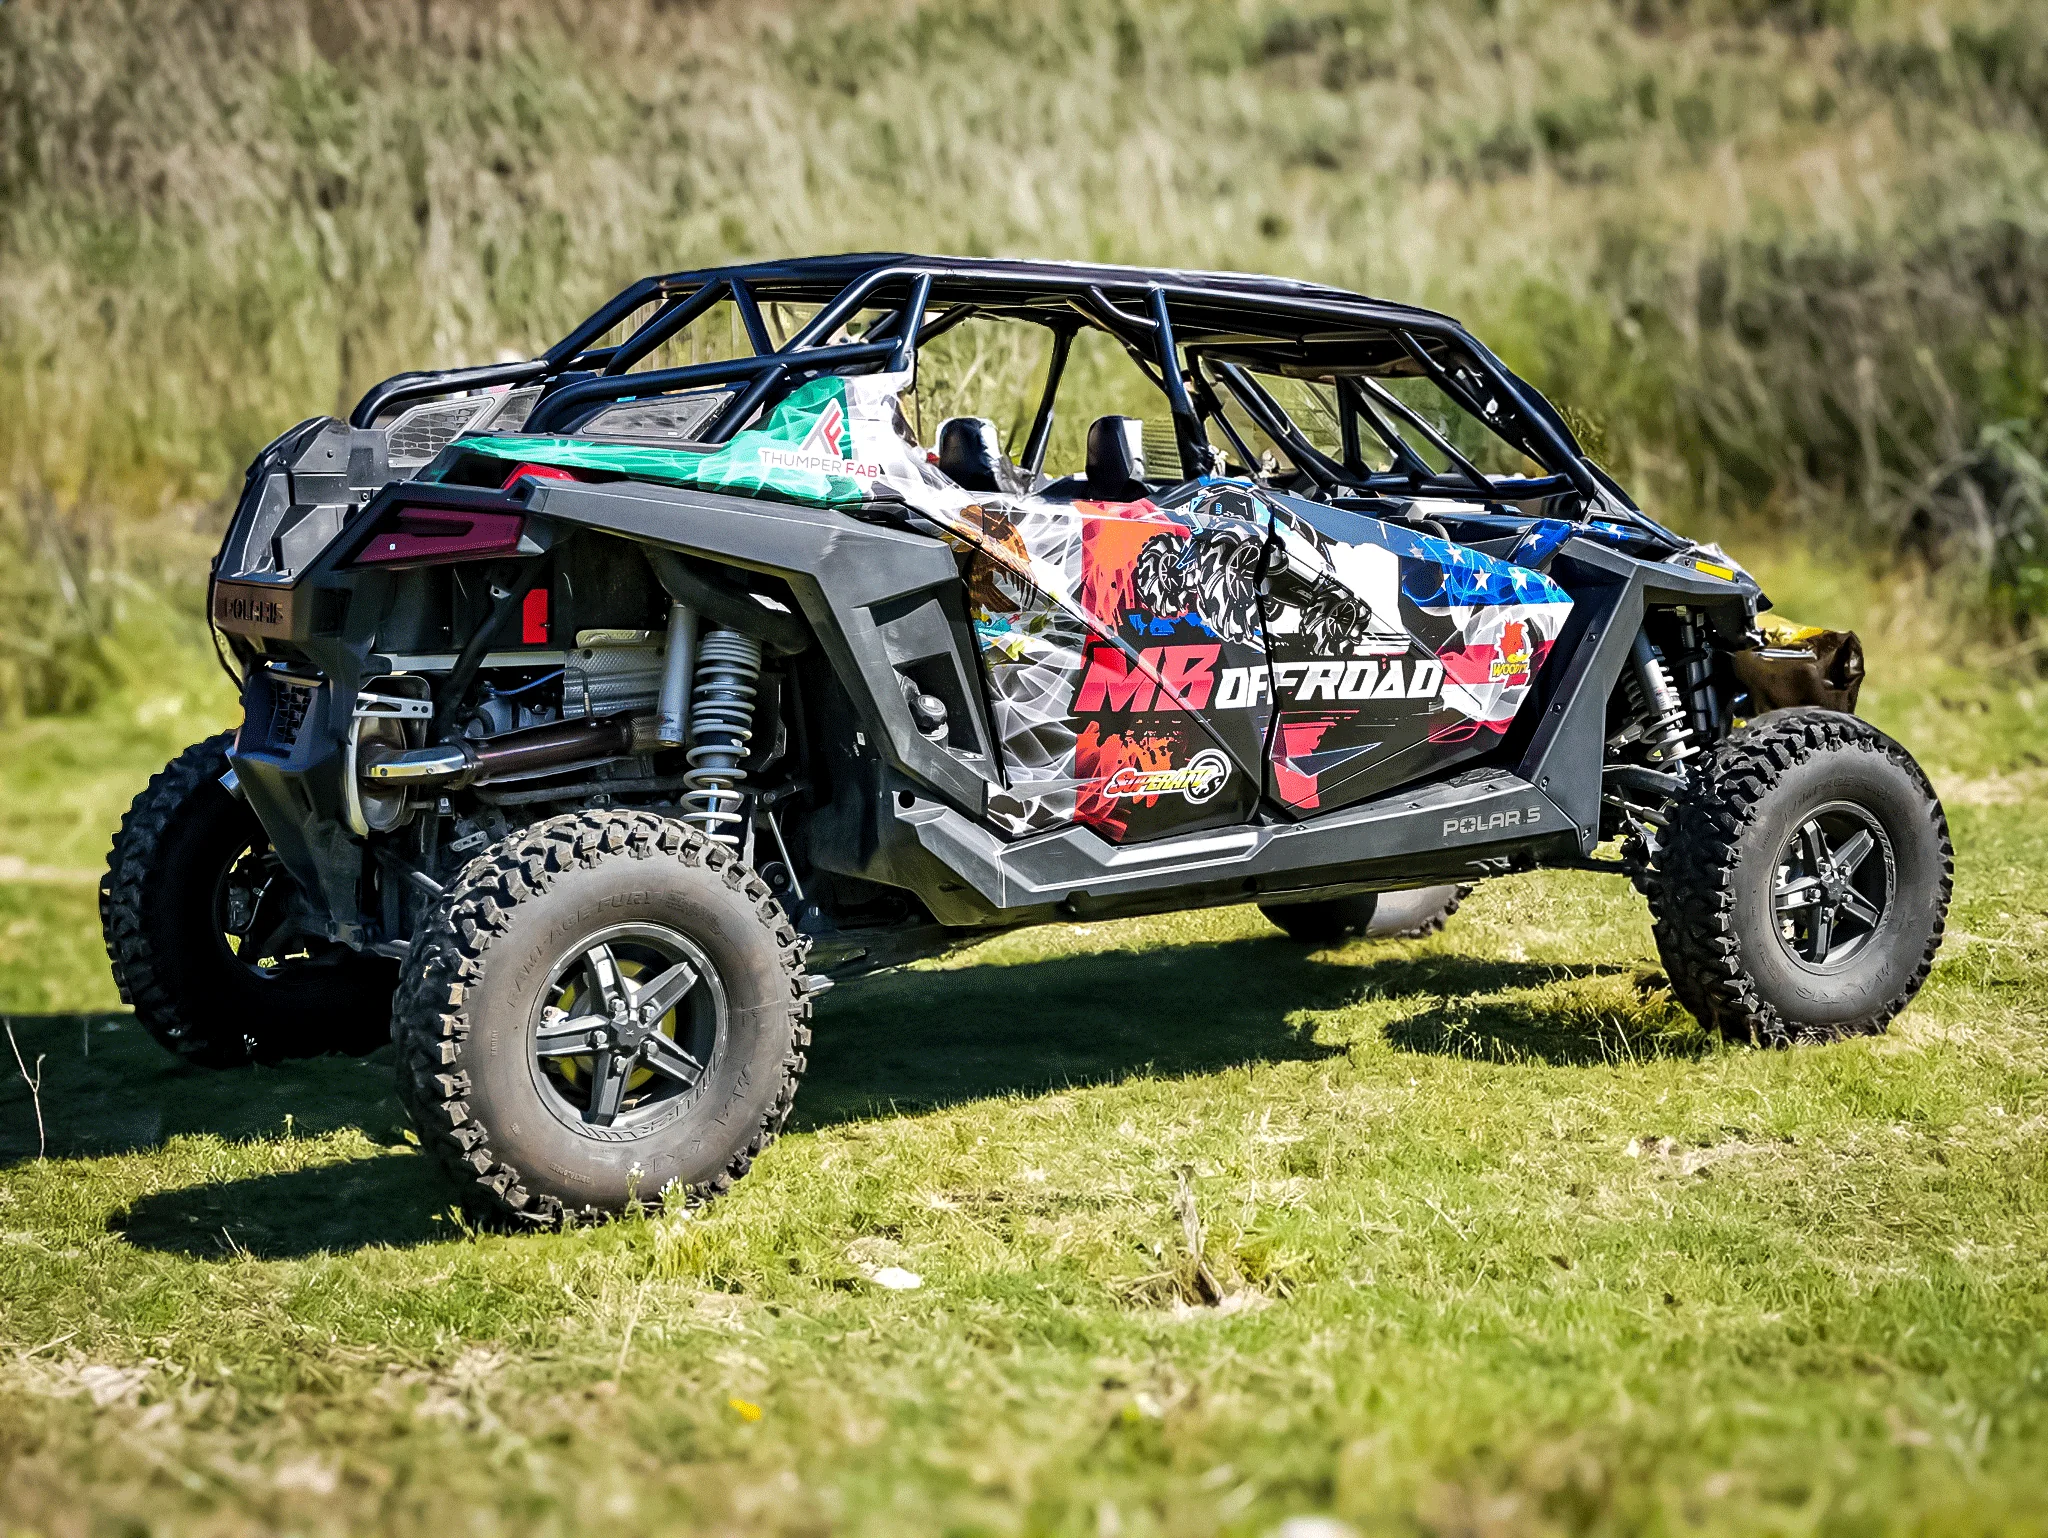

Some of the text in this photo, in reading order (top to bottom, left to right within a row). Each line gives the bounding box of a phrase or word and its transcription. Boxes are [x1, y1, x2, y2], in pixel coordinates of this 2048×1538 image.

[761, 450, 878, 478] THUMPER FAB
[1074, 644, 1444, 712] MB OFFROAD
[1106, 768, 1215, 794] SUPERATV
